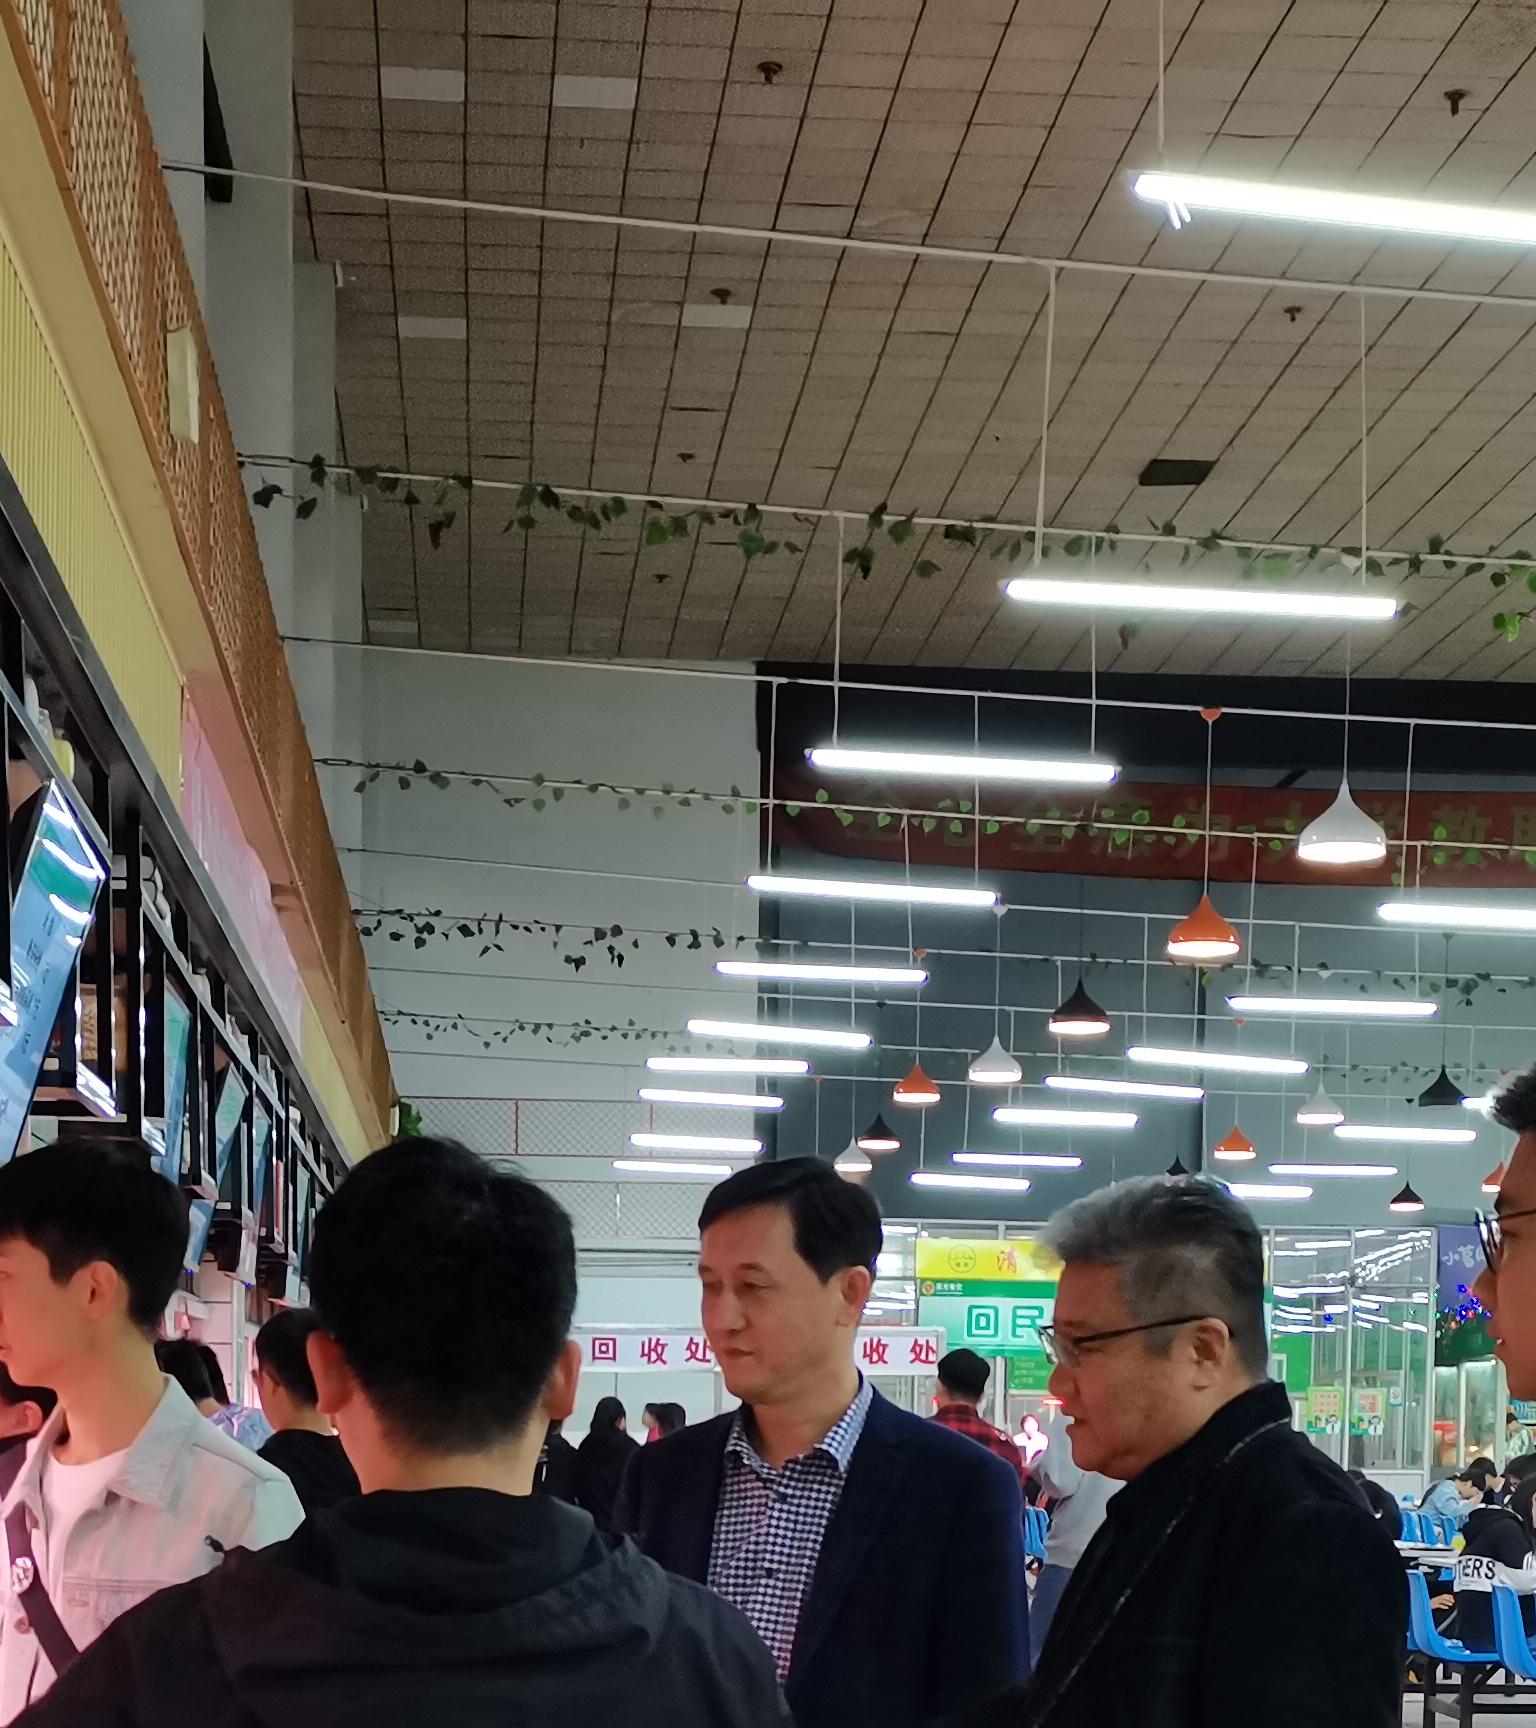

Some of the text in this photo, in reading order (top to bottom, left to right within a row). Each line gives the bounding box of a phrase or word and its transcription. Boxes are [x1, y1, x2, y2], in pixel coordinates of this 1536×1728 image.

[592, 1336, 937, 1364] 回收处 收处
